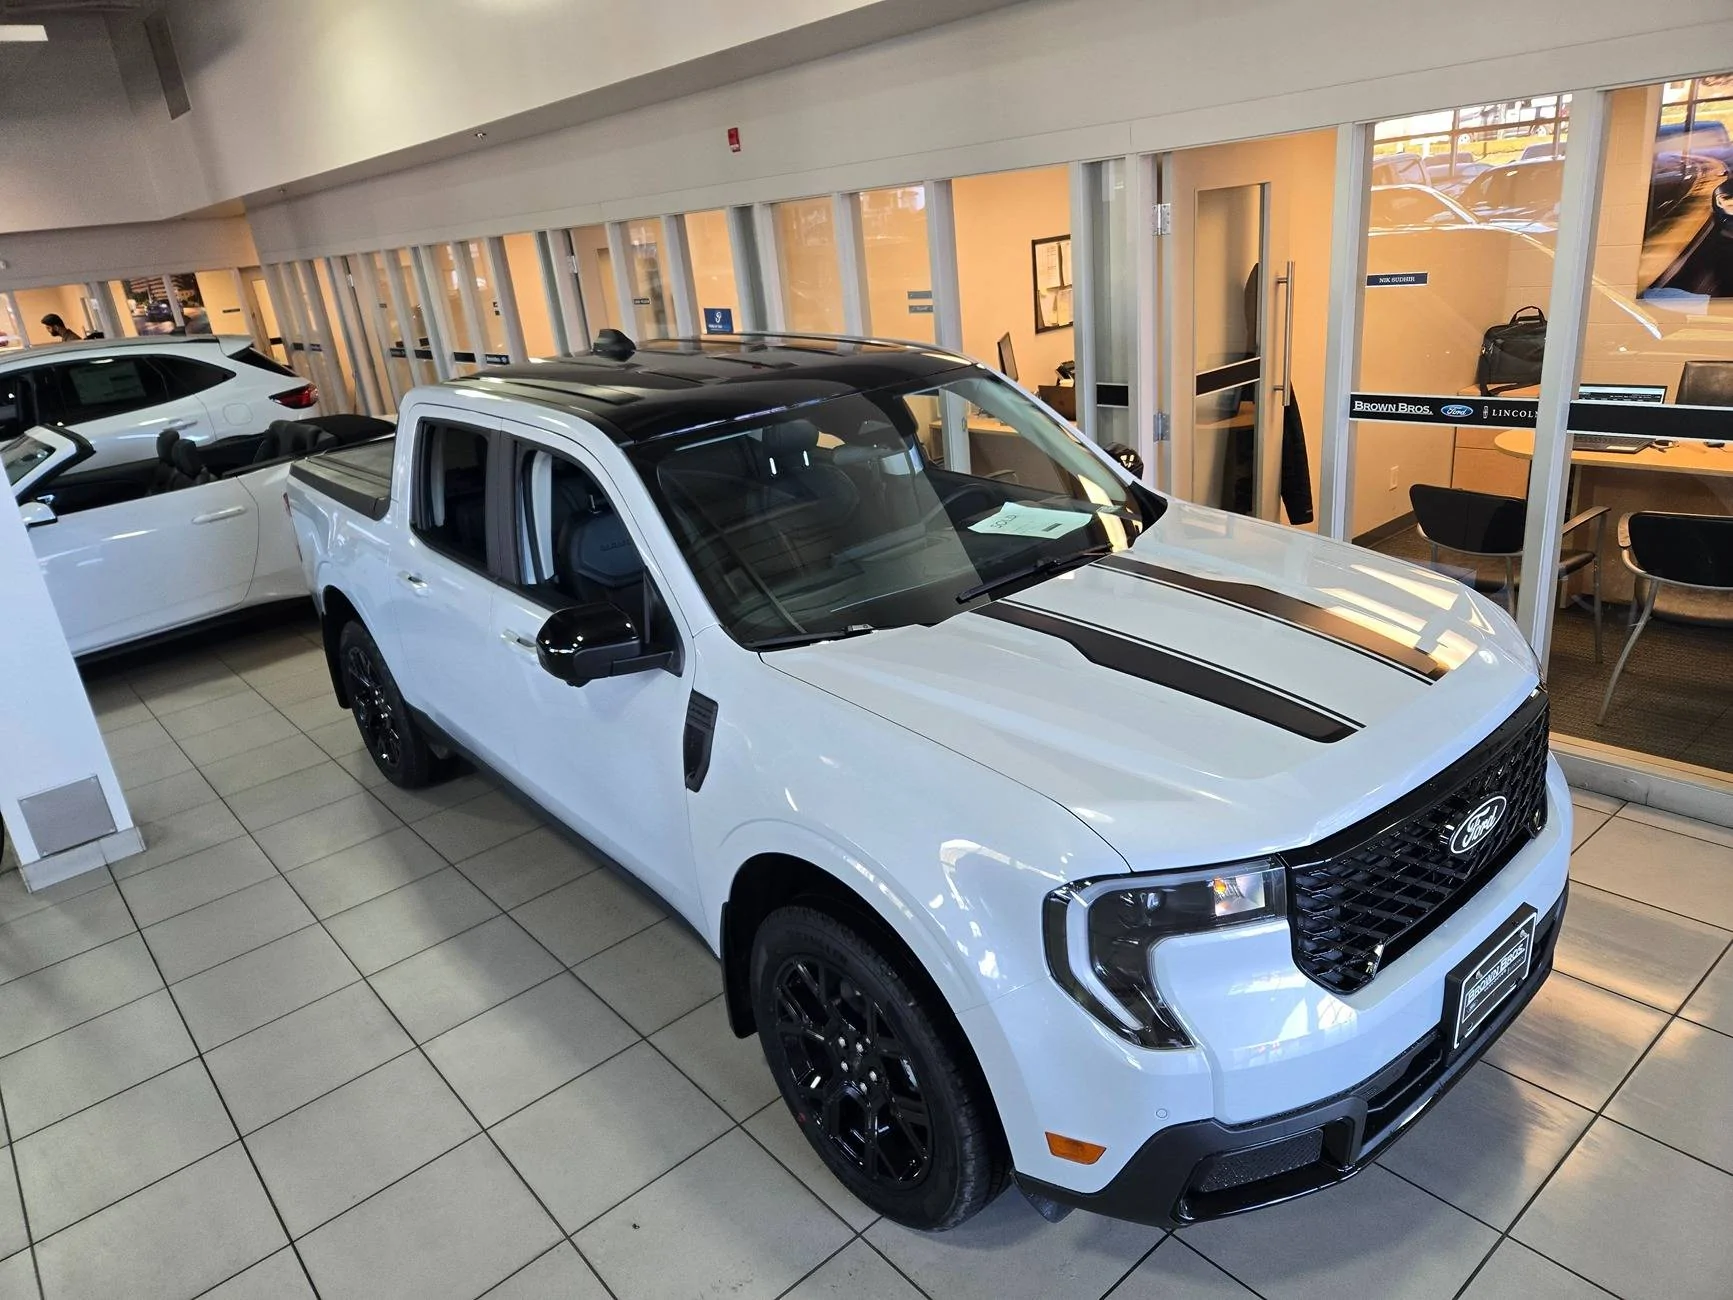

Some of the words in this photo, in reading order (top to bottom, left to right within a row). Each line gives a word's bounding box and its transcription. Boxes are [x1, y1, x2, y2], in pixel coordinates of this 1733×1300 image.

[1354, 401, 1396, 412] BROWN
[1398, 402, 1434, 415] BROS.
[1445, 405, 1469, 416] Ford
[1460, 803, 1500, 849] Ford
[1466, 963, 1501, 1007] BROWN
